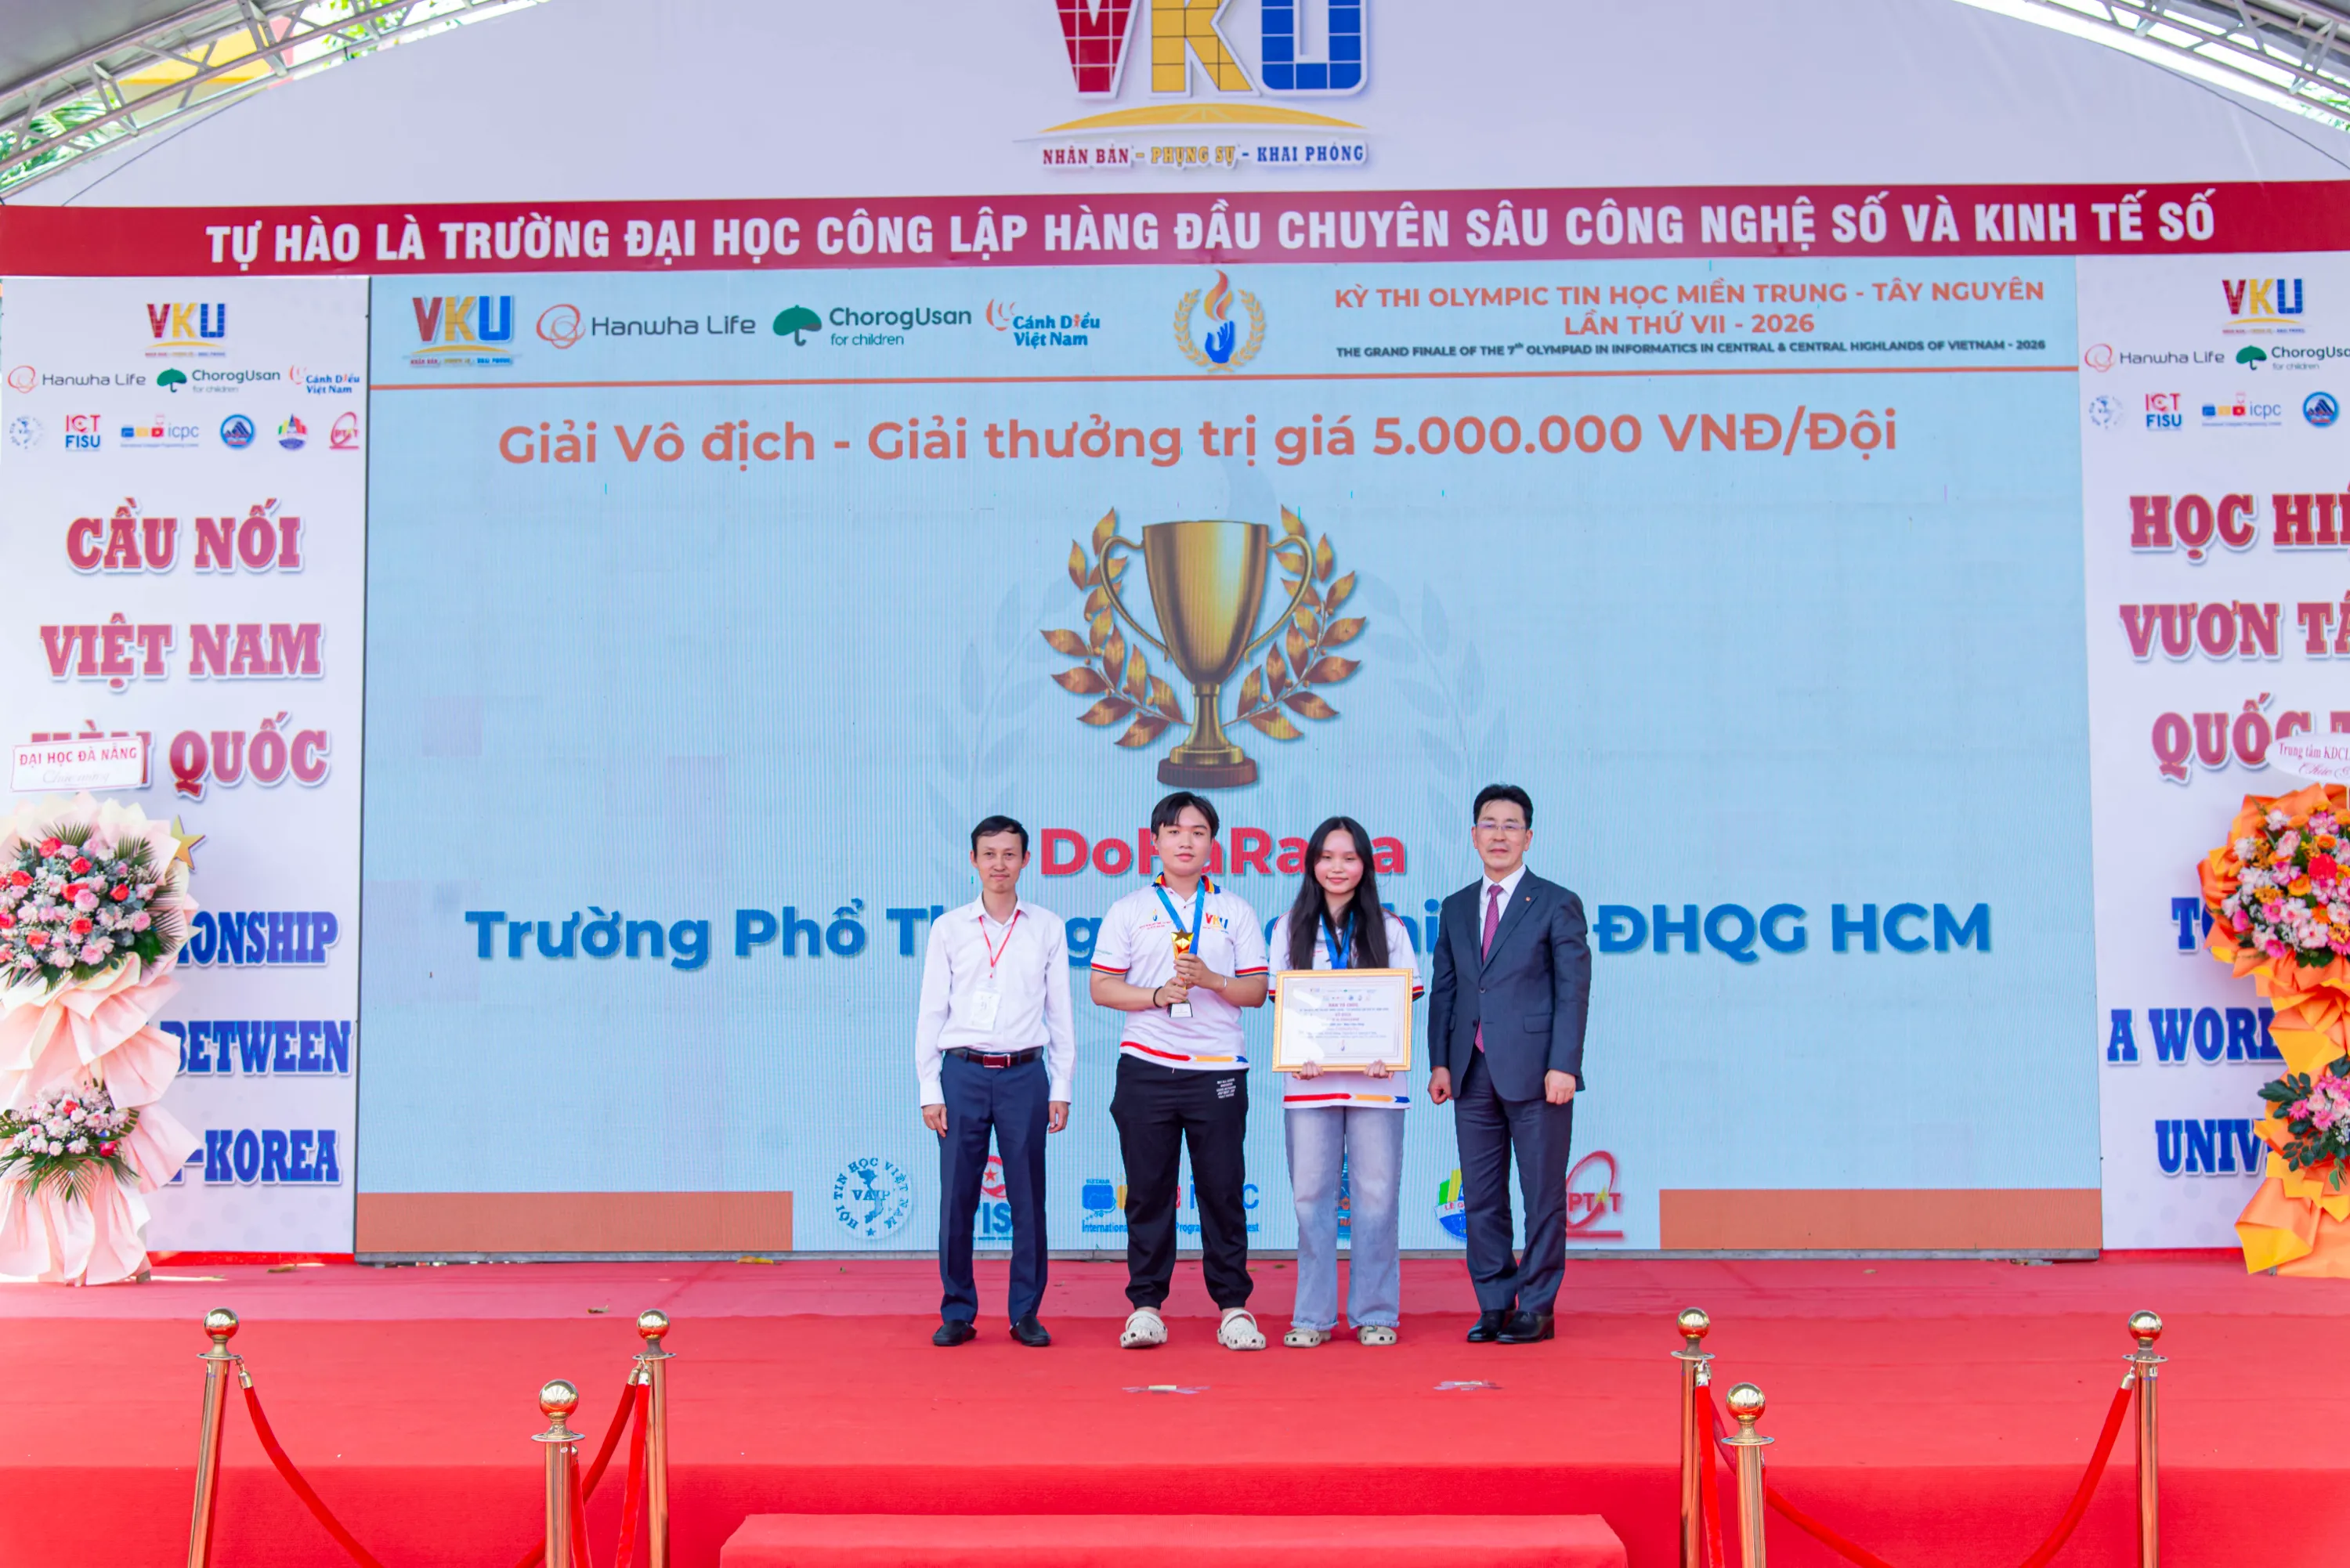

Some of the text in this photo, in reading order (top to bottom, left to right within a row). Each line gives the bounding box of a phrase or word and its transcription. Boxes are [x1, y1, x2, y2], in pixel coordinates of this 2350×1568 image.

[1057, 0, 1362, 92] VKU
[1152, 146, 1208, 166] PHỤNG
[1257, 146, 1297, 161] KHAI
[206, 188, 2215, 271] TỰ HÀO LÀ TRƯỜNG ĐẠI HỌC CÔNG LẬP HÀNG ĐẦU CHUYÊN SÂU CÔNG NGHỆ SỐ VÀ KINH TẾ SỐ
[1336, 284, 1368, 308] KỲ
[1376, 288, 1419, 307] THI
[1429, 287, 1548, 307] OLYMPIC
[1556, 287, 1600, 305] TIN
[1610, 285, 1668, 309] HỌC
[1678, 278, 1744, 303] MIỀN
[1753, 284, 1846, 302] TRUNG
[1872, 277, 1922, 302] TÂY
[1932, 276, 2043, 301] NGUYÊN
[2222, 279, 2303, 315] VKU
[146, 303, 226, 338] VKU
[412, 295, 512, 341] VKU
[592, 316, 755, 335] Hanwha Life
[830, 307, 971, 330] ChorogUsan
[1013, 315, 1055, 329] Cánh
[1565, 309, 1618, 335] LẦN
[1626, 310, 1683, 334] THỨ
[1690, 315, 1725, 334] VII
[1752, 313, 1814, 333] 2026
[830, 333, 904, 345] for children
[1014, 331, 1088, 349] Việt Nam
[1336, 347, 1361, 357] THE
[1365, 347, 1408, 357] GRAND
[1412, 346, 1455, 356] FINALE
[1459, 346, 1477, 356] OF
[1480, 345, 1504, 356] THE
[1527, 345, 1592, 355] OLYMPIAD
[1596, 345, 1607, 354] IN
[1612, 343, 1697, 354] INFORMATICS
[1701, 343, 1713, 352] IN
[1717, 342, 1774, 352] CENTRAL
[1778, 343, 1786, 352] &
[1789, 341, 1846, 352] CENTRAL
[1850, 341, 1924, 351] HIGHLANDS
[1928, 341, 1944, 350] OF
[1948, 340, 2005, 350] VIETNAM
[2016, 341, 2046, 349] 2026
[2120, 351, 2225, 364] Hanwha Life
[2272, 345, 2350, 360] ChorogUsa
[42, 374, 146, 385] Hanwha Life
[192, 369, 280, 384] ChorogUsan
[329, 385, 352, 393] Nam
[2146, 393, 2181, 411] ICT
[2250, 401, 2281, 419] icpc
[66, 414, 100, 432] ICT
[2146, 414, 2182, 427] FISU
[66, 435, 100, 448] FISU
[168, 423, 199, 440] icpc
[499, 420, 597, 464] Giải
[614, 422, 685, 462] Vô
[702, 420, 814, 471] địch
[869, 415, 967, 460] Giải
[984, 414, 1182, 467] thưởng
[1198, 414, 1256, 467] trị
[1275, 414, 1354, 466] giá
[1373, 414, 1642, 455] 5.000.000
[1658, 406, 1895, 460] VNĐ/Đội
[67, 497, 301, 569] CẦU NỐI
[2129, 493, 2254, 559] HỌC
[2119, 601, 2280, 656] VƯƠN
[39, 612, 321, 688] VIỆT NAM
[20, 752, 42, 768] ĐẠI
[47, 751, 74, 767] HỌC
[78, 746, 96, 762] ĐÀ
[169, 711, 327, 797] QUỐC
[2279, 742, 2303, 761] Trung
[465, 905, 710, 970] Trường
[736, 898, 867, 957] Phổ
[1593, 902, 1807, 963] ĐHQG
[1831, 902, 1991, 952] HCM
[2107, 1009, 2138, 1061] A
[2155, 1118, 2272, 1173] UNIV
[833, 1173, 848, 1200] TIN
[848, 1158, 878, 1172] HỌC
[1082, 1219, 1128, 1233] Internationa
